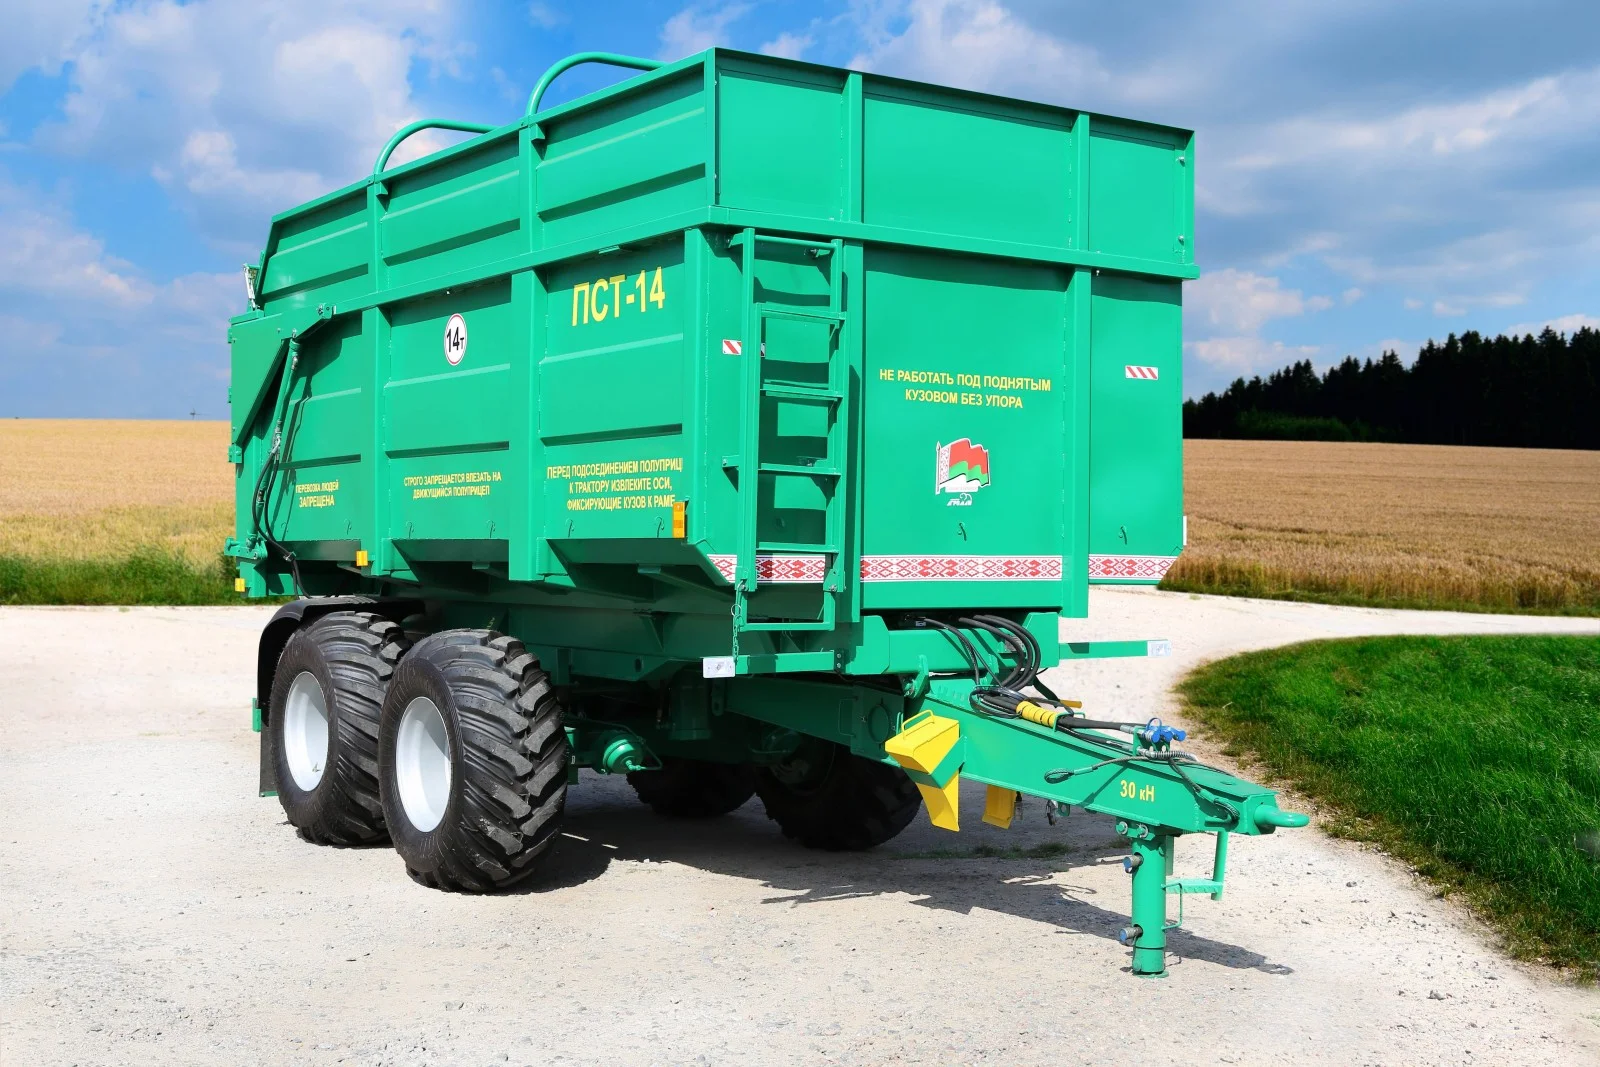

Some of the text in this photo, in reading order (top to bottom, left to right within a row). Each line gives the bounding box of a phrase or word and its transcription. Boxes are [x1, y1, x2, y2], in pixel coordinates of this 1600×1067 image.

[572, 266, 666, 327] ПСТ-14
[879, 368, 1051, 391] НЕ РАБОТАТЬ ПОД ПОДНЯТЫМ
[905, 389, 1023, 409] КУЗОВОМ БЕЗ УПОРА
[404, 471, 502, 487] СТРОГО ЗАПРЕЩАЕТСЯ ВЛЕЗАТЬ НА
[547, 465, 571, 479] ПЕРЕД
[572, 461, 638, 478] ПОДСОЕДИНЕНИЕМ
[413, 485, 490, 501] ДВИЖУЩИЙСЯ ПОЛУПРИЦЕП
[569, 482, 574, 494] К
[575, 479, 610, 493] ТРАКТОРУ
[611, 478, 651, 492] ИЗВЛЕКИТЕ
[567, 494, 676, 511] ФИКСИРУЮЩИЕ КУЗОВ К РАМЕ
[1120, 780, 1136, 798] 30
